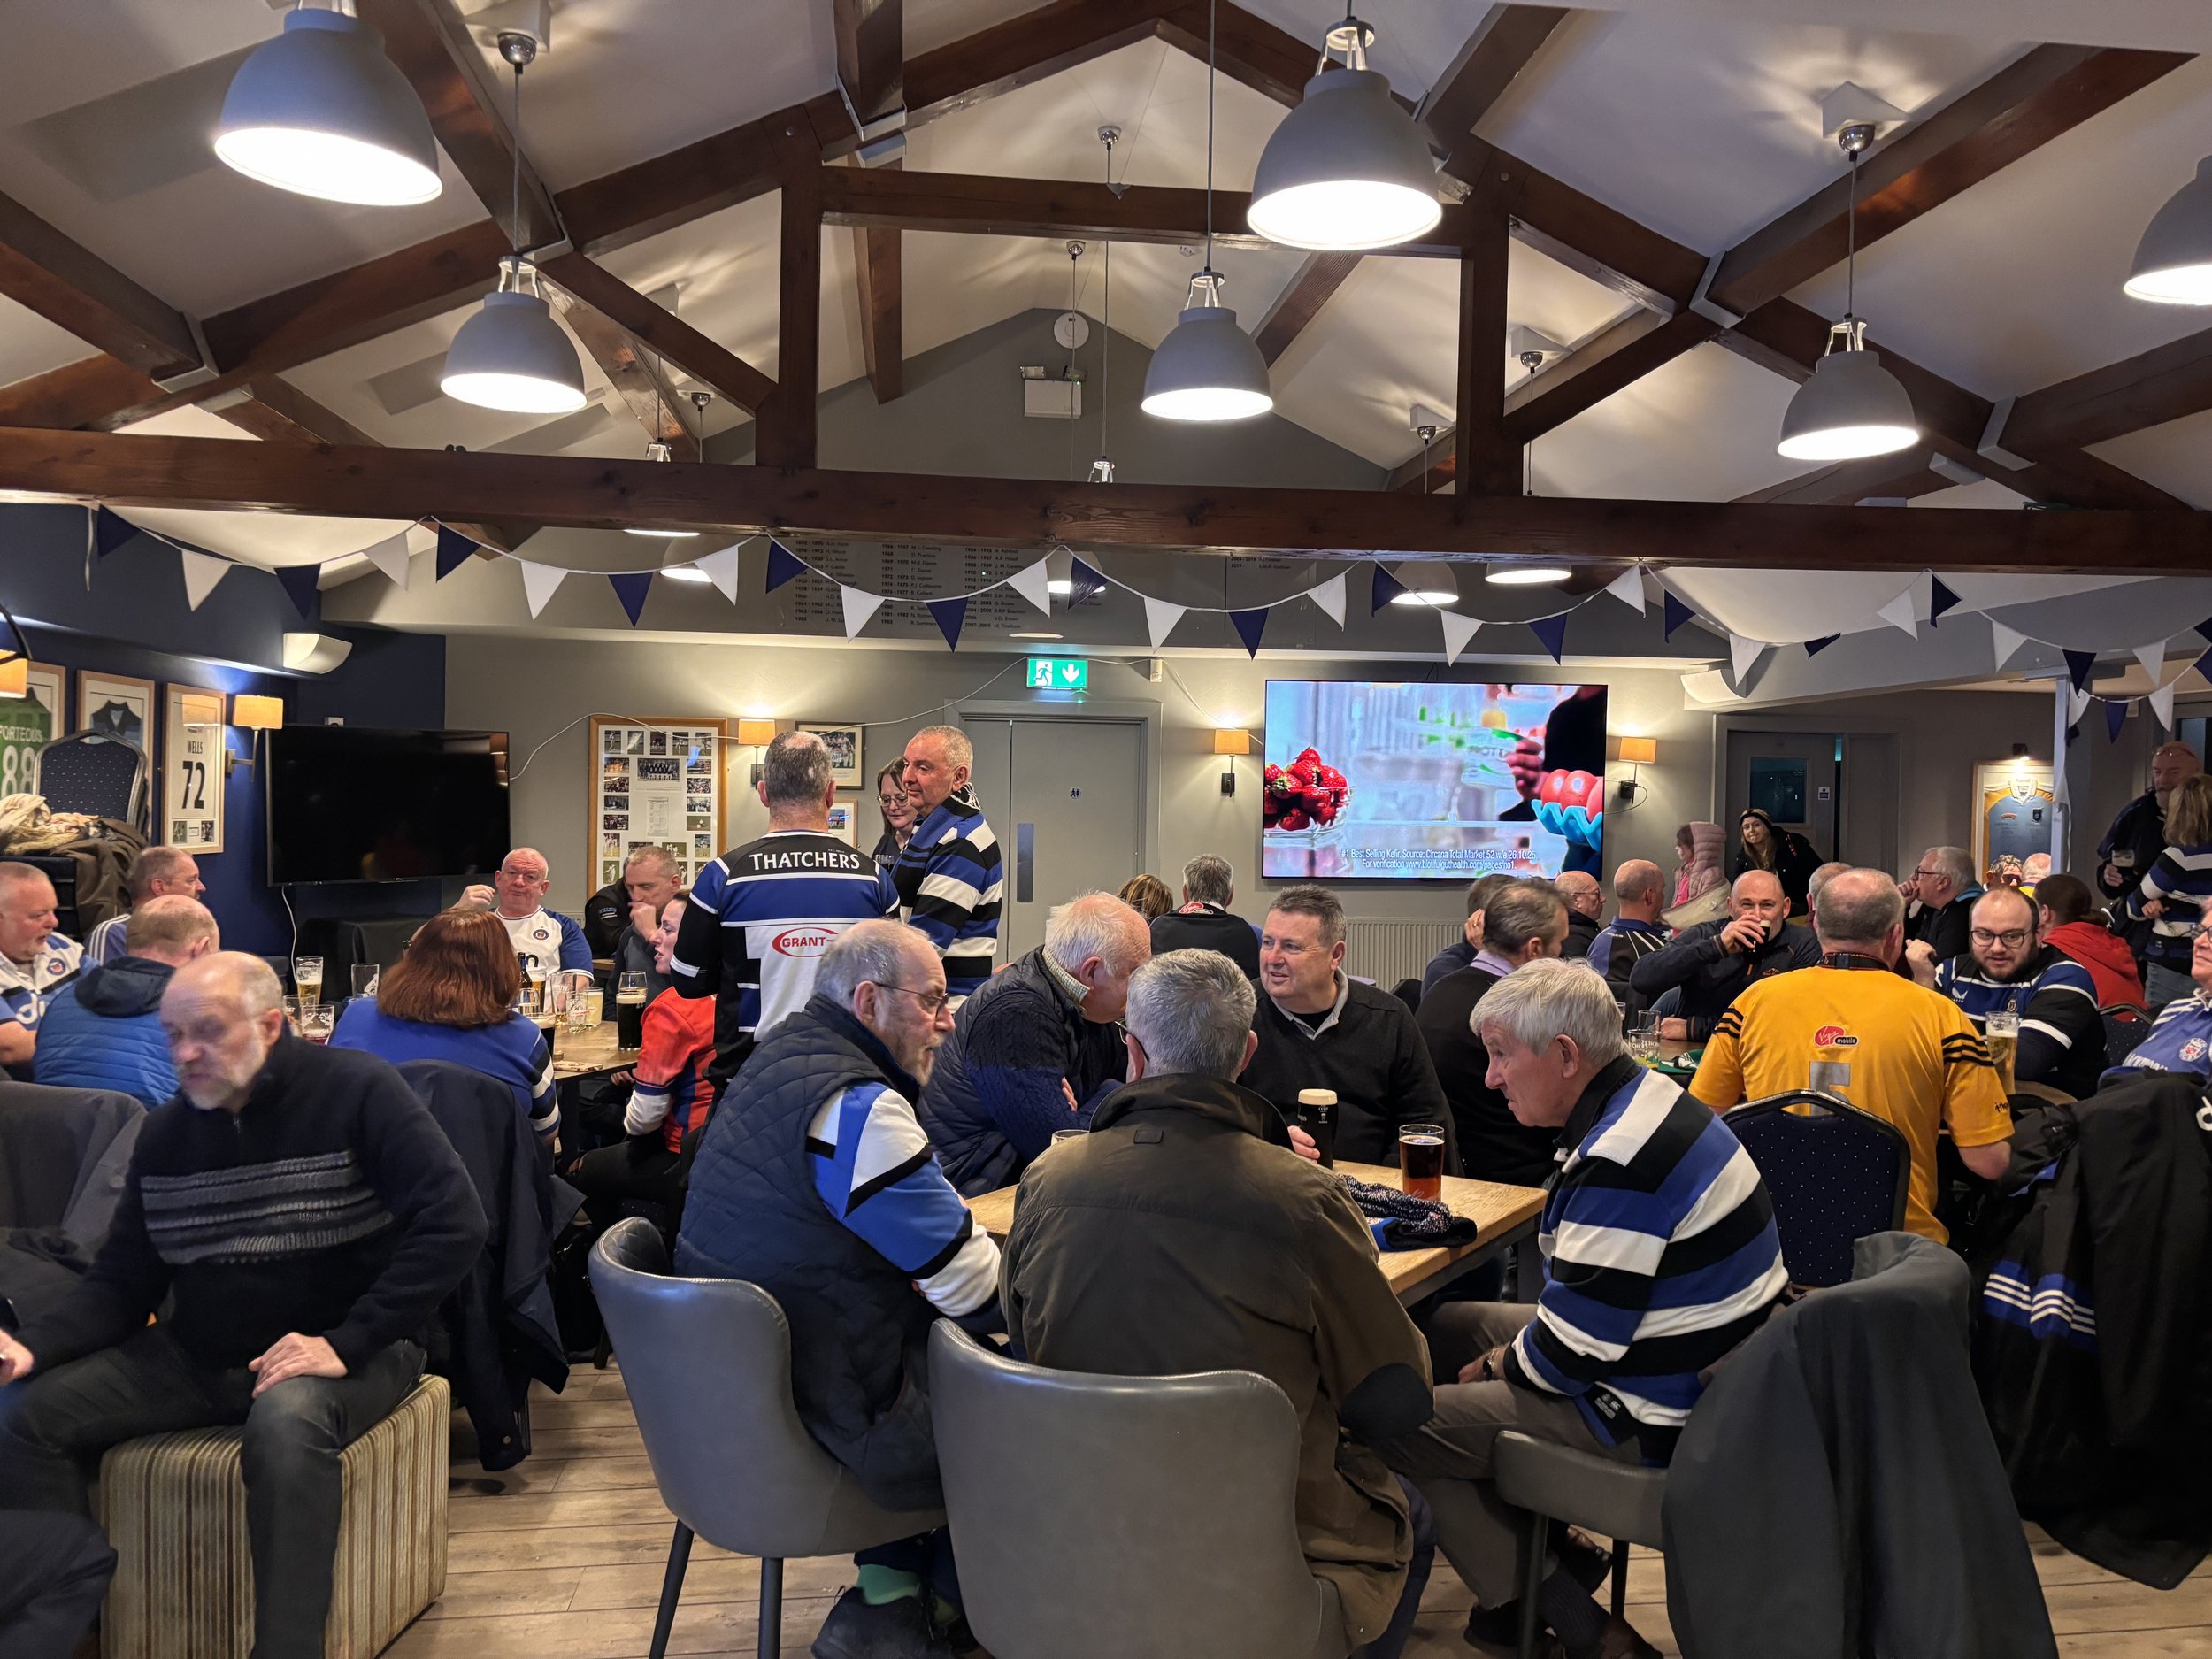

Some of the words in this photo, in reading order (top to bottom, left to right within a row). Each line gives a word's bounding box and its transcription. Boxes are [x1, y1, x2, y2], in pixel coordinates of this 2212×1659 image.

[187, 741, 204, 755] WELLS
[181, 760, 205, 810] 72
[749, 851, 860, 871] THATCHERS
[1341, 849, 1349, 858] #1
[1351, 849, 1364, 858] Best
[1365, 849, 1386, 860] Selling
[1402, 849, 1425, 859] Source:
[1425, 849, 1448, 859] Circana
[1449, 849, 1463, 859] Total
[1465, 849, 1486, 859] Market
[1486, 849, 1494, 858] 52
[1362, 859, 1372, 868] For
[1373, 859, 1405, 868] verification
[781, 936, 826, 948] GRANT
[1818, 1026, 1839, 1044] Virgin
[1837, 1036, 1856, 1045] mobile
